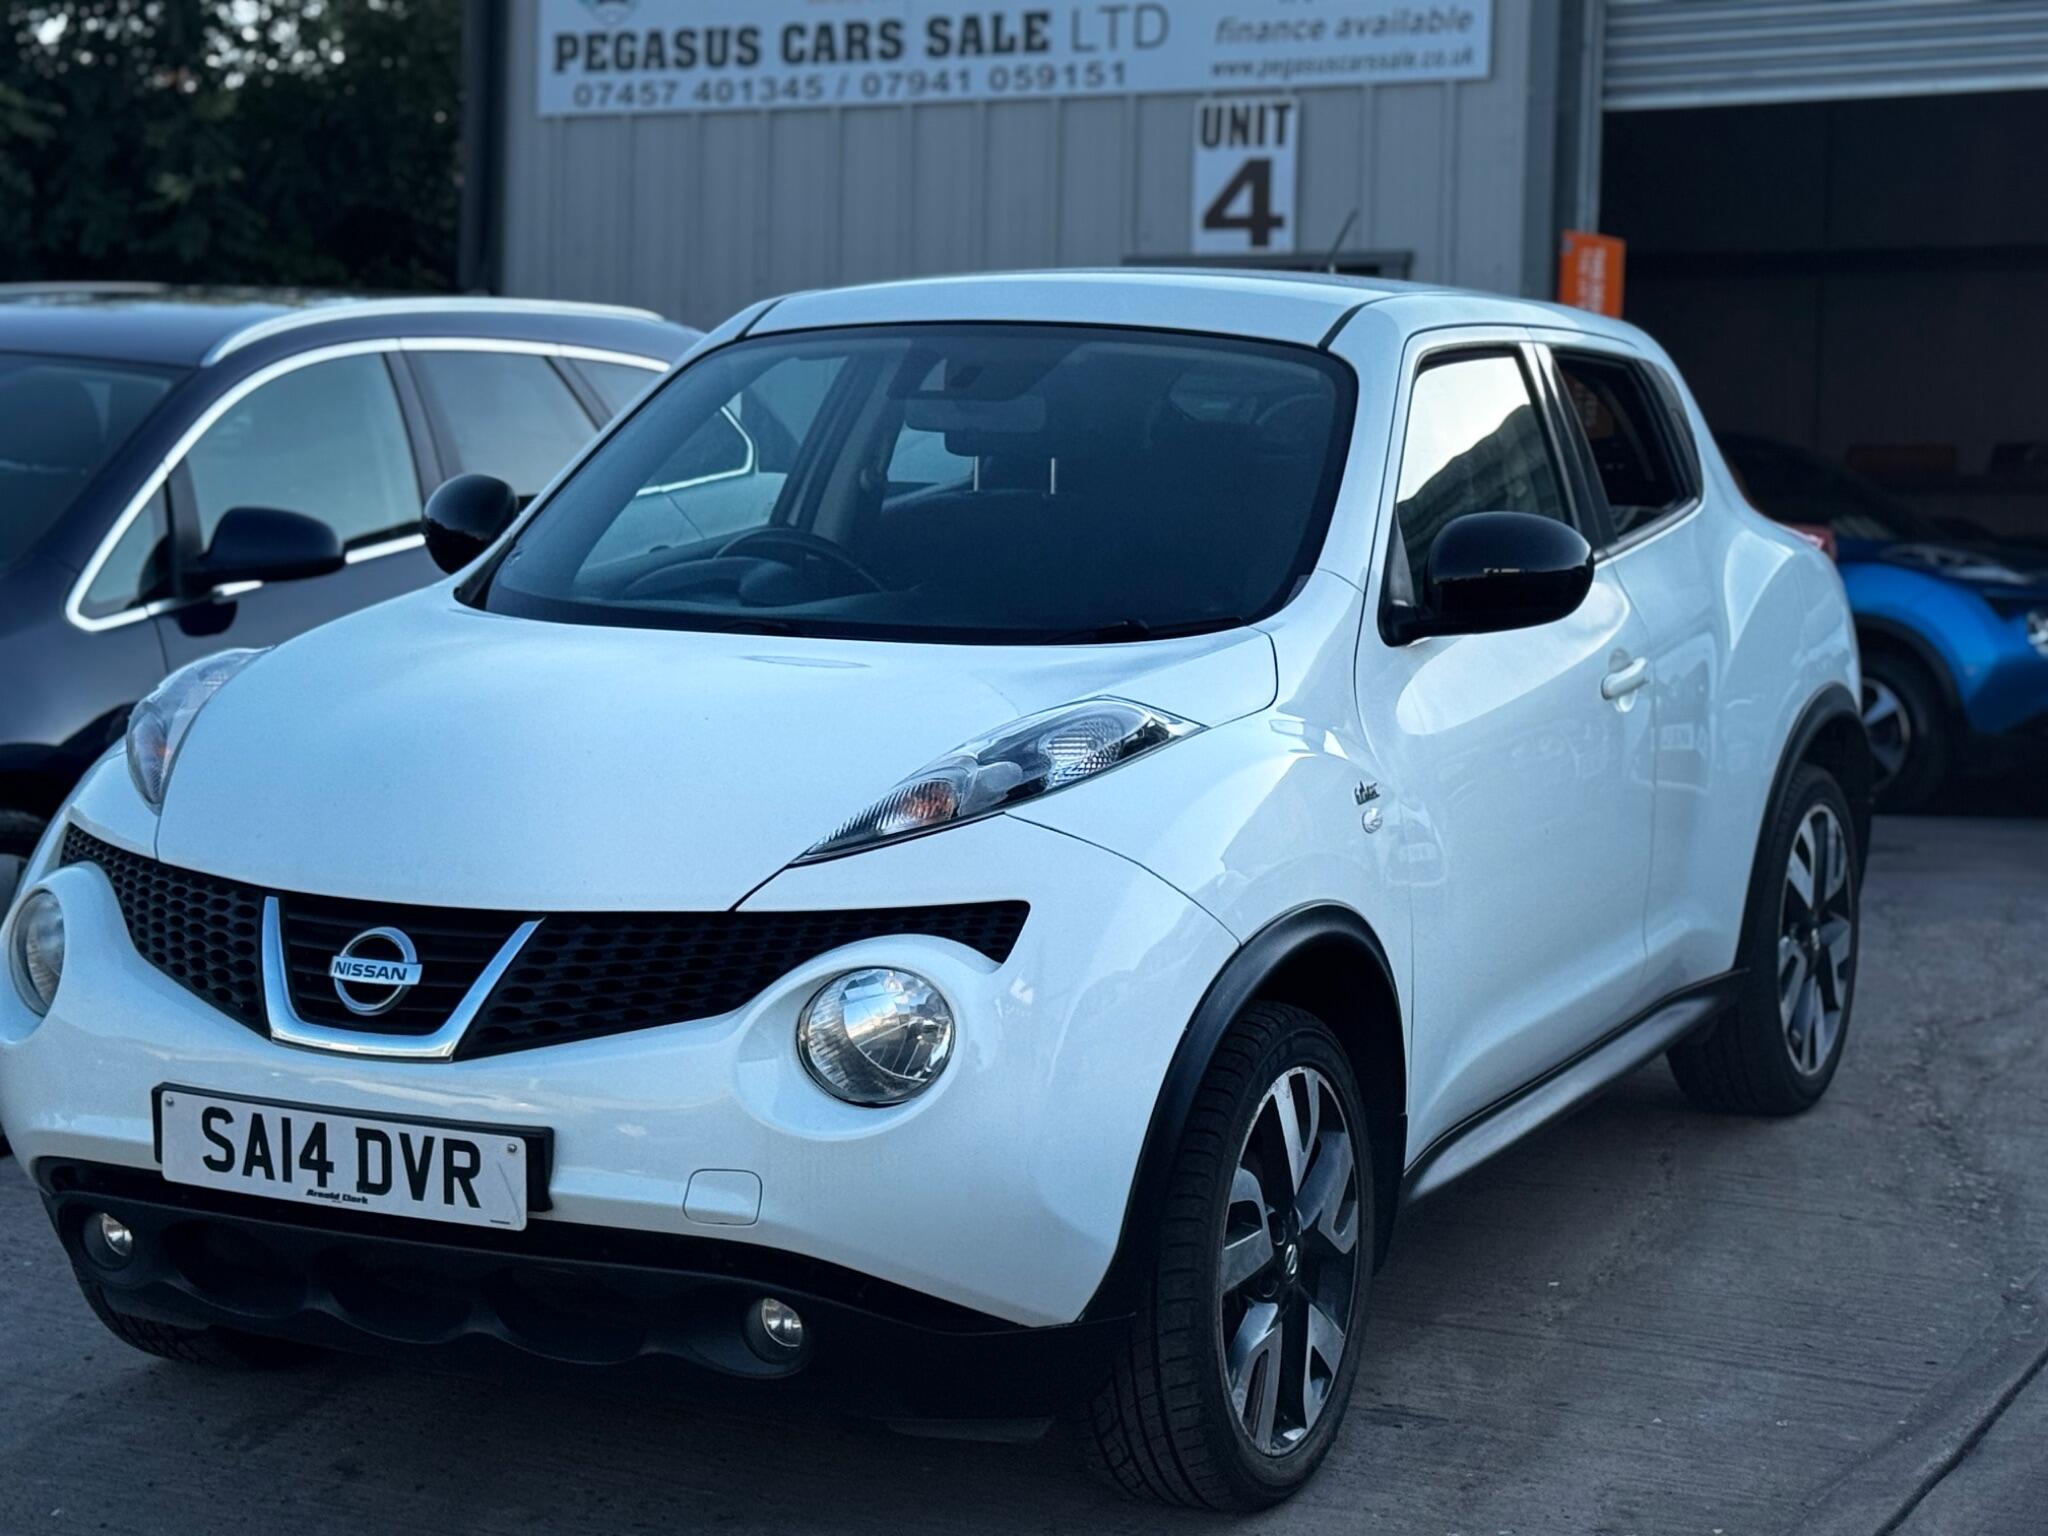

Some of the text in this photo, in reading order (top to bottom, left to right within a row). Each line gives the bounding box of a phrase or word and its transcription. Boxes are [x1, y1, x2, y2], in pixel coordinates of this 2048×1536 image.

[554, 2, 1170, 73] PEGASUS CARS SALE LTD
[1214, 6, 1475, 44] finance available
[574, 80, 678, 107] 07457
[692, 74, 824, 104] 401345
[861, 69, 970, 97] 07941
[988, 61, 1125, 91] 059151
[1201, 105, 1292, 148] UNIT
[1203, 158, 1284, 248] 4
[333, 961, 408, 981] NISSAN
[202, 1106, 482, 1209] SA14 DVR
